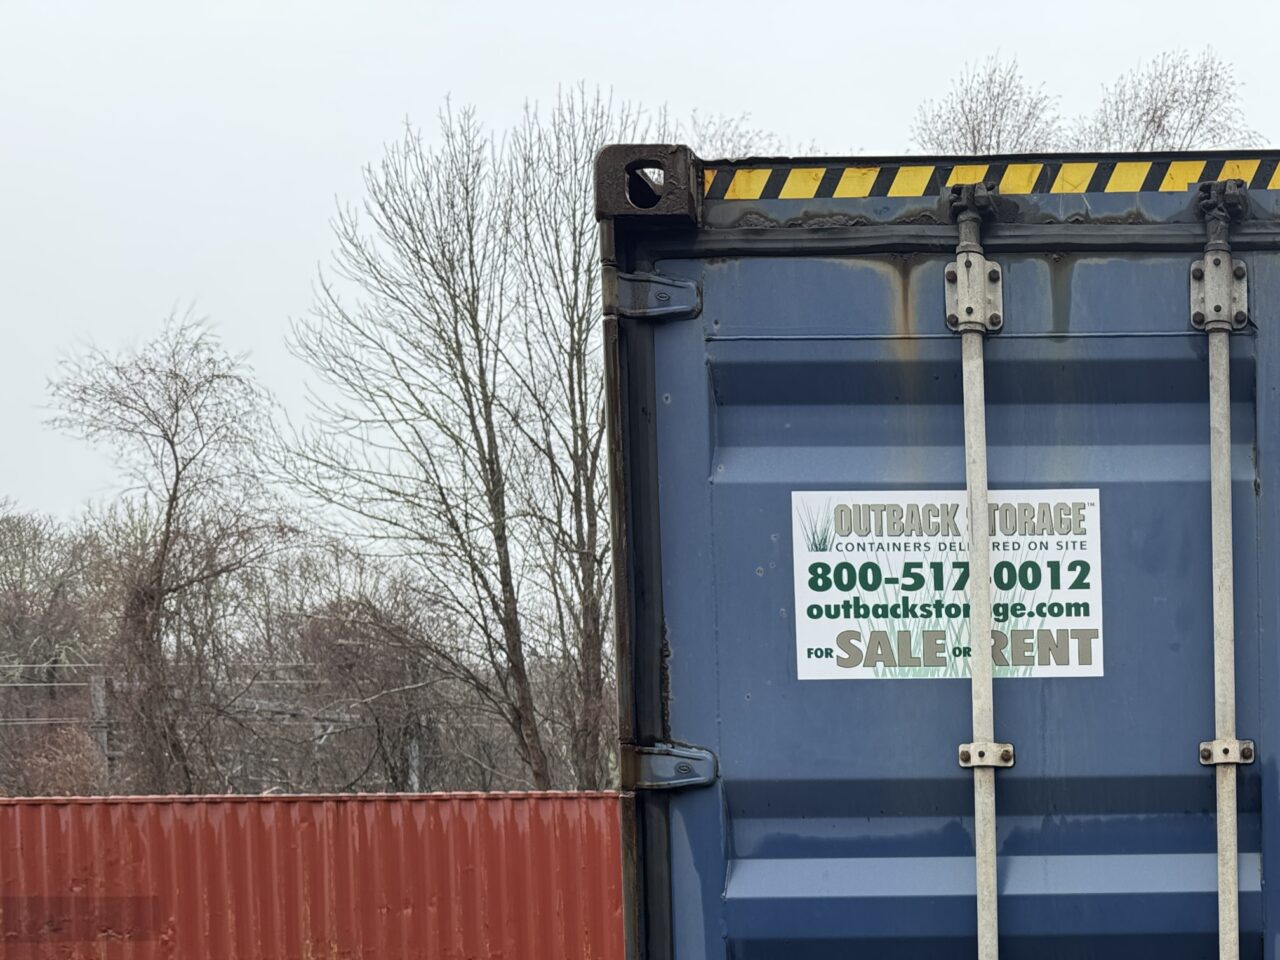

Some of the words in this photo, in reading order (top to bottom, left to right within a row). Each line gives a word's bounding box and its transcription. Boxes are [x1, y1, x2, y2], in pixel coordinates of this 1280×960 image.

[834, 503, 961, 537] OUTBACK
[966, 502, 1087, 536] TORAGE
[835, 541, 931, 552] CONTAINERS
[1028, 541, 1049, 551] ON
[1056, 540, 1088, 551] SITE
[807, 559, 1091, 592] 800-5170012
[806, 596, 1090, 623] outbackstorge.com
[807, 647, 834, 659] FOR
[836, 629, 947, 668] SALE
[952, 646, 972, 658] OR
[991, 628, 1099, 667] RENT
